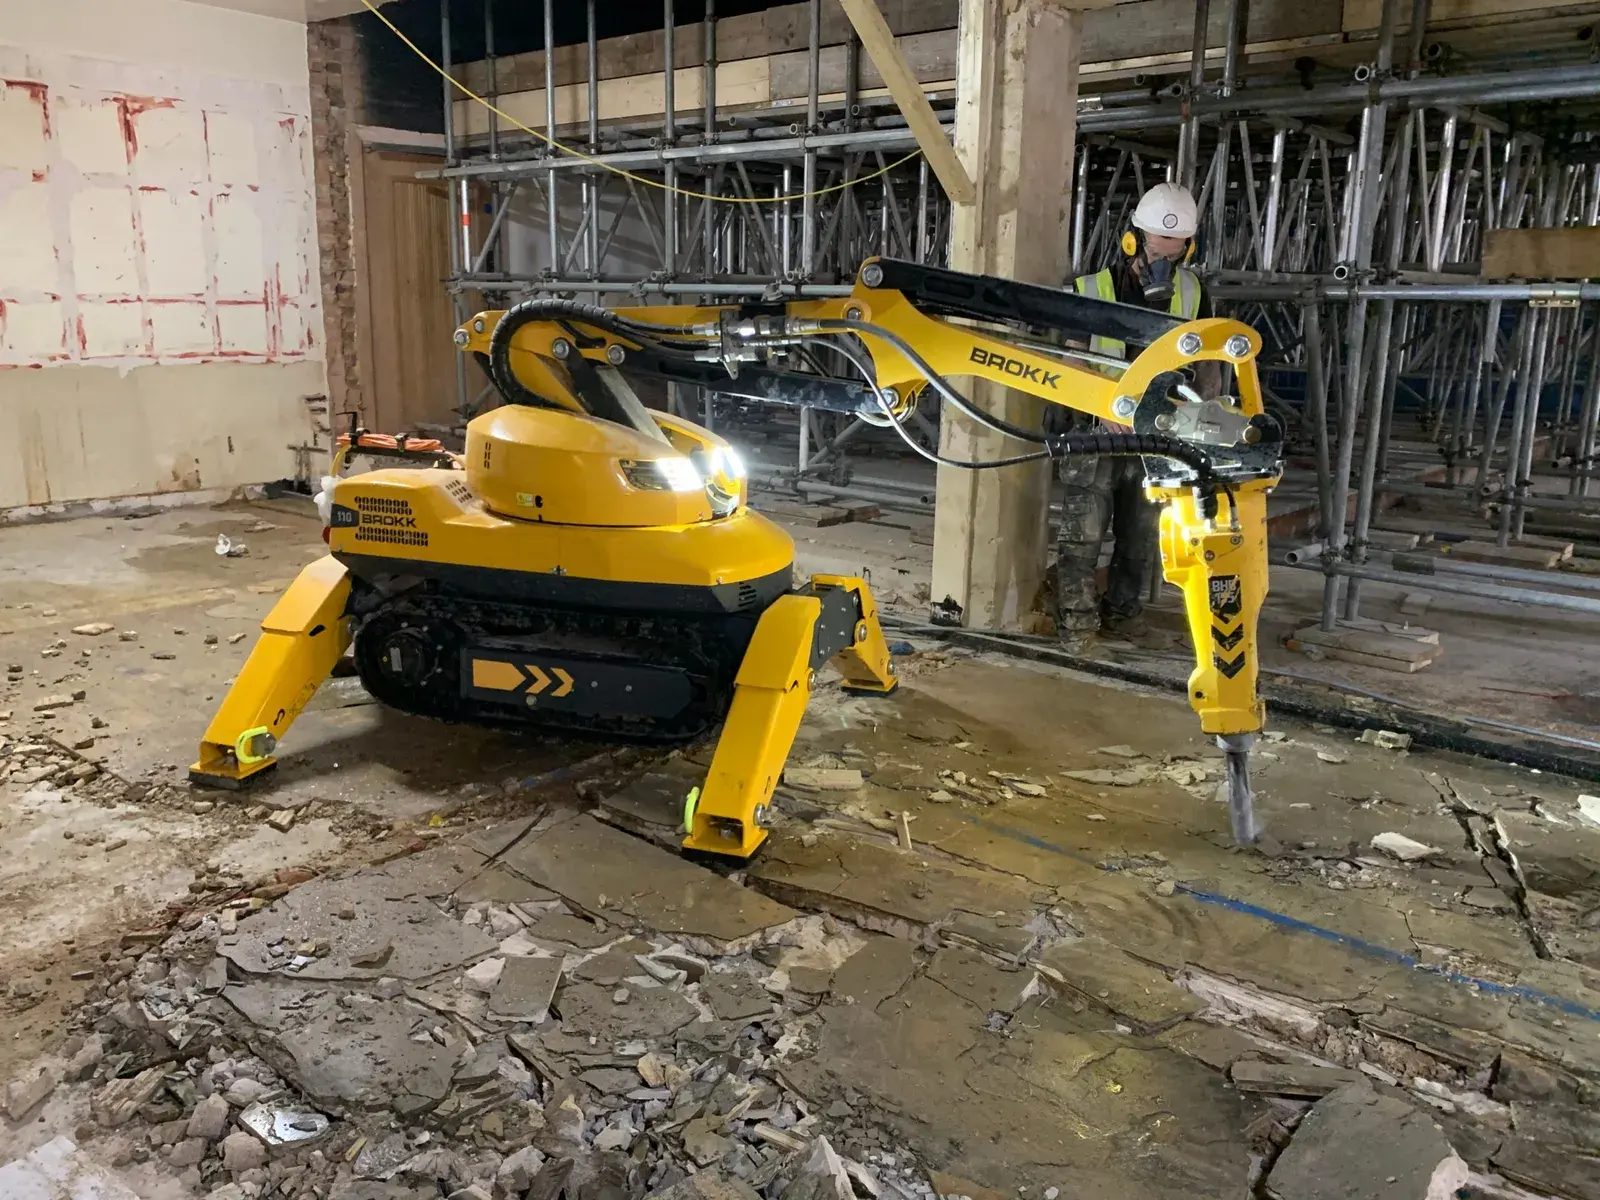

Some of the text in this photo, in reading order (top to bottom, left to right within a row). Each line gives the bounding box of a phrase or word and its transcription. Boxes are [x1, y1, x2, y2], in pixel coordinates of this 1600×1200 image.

[969, 346, 1062, 389] BROKK
[337, 511, 352, 523] 110
[361, 513, 417, 528] BROKK
